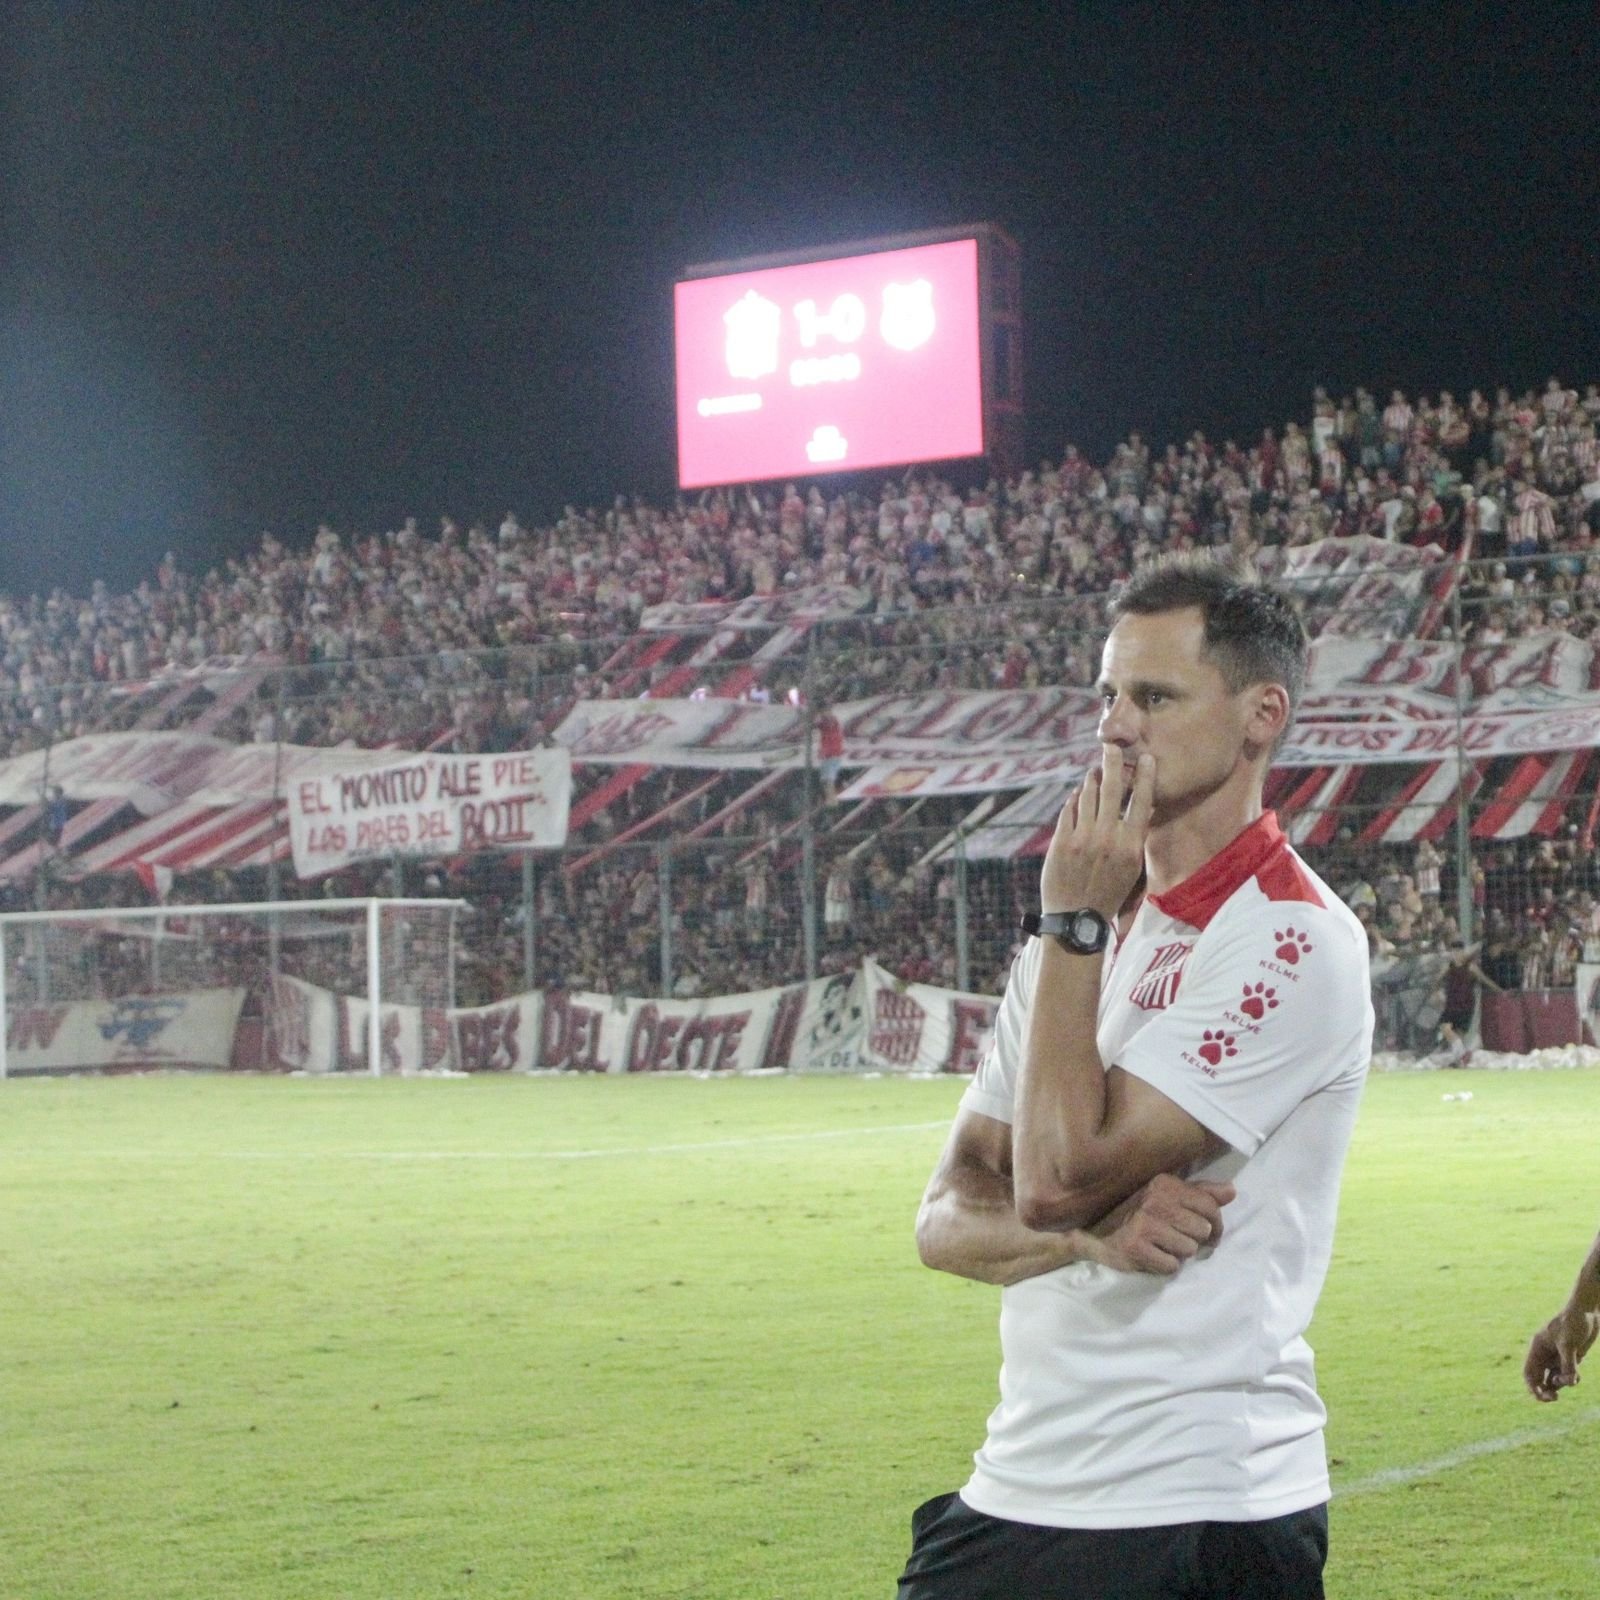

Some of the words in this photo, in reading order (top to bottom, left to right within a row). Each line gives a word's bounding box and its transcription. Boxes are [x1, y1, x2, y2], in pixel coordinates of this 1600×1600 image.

[299, 780, 332, 814] EL
[437, 760, 482, 799] ALE
[308, 823, 347, 853] LOS
[417, 809, 453, 839] DEL
[1258, 959, 1300, 983] KELME
[1222, 1010, 1263, 1035] KELME
[1180, 1051, 1219, 1079] KELME
